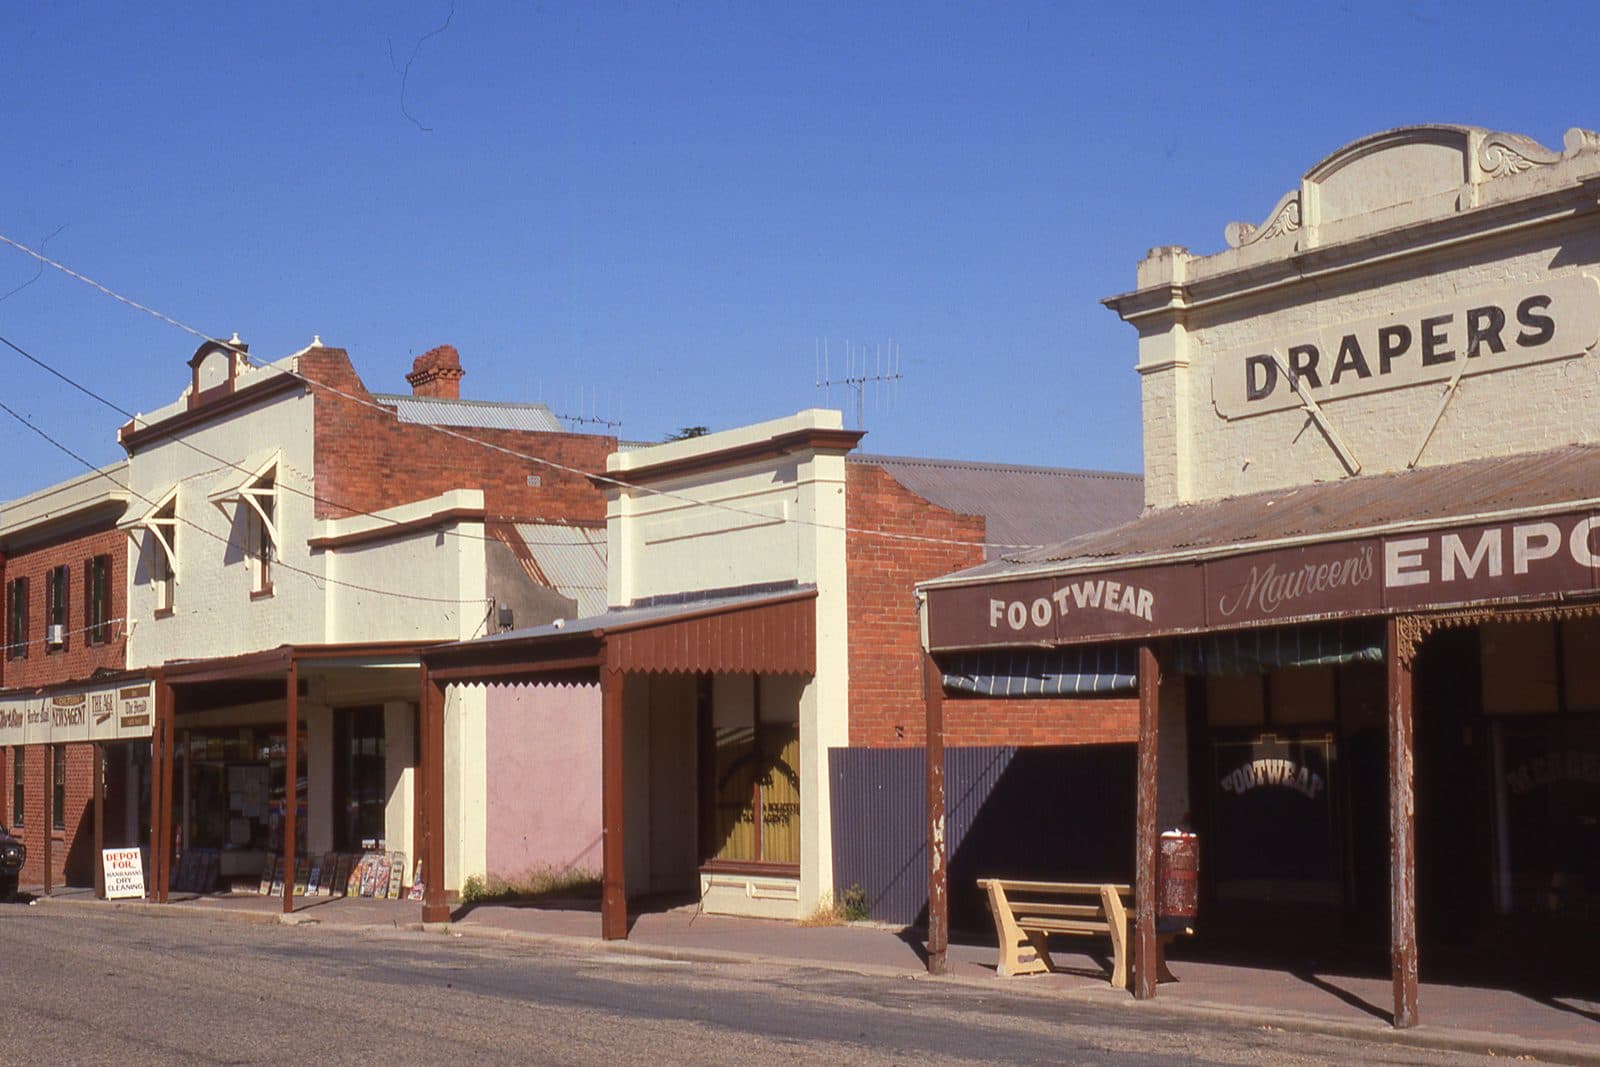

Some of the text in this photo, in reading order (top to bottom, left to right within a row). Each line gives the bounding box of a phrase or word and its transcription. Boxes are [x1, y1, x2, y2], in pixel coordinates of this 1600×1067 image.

[1246, 295, 1556, 402] DRAPERS
[1220, 545, 1374, 617] Maureen's
[989, 580, 1154, 631] FOOTWEAR
[52, 703, 86, 729] NEWSAGENT
[106, 852, 138, 861] DEPOT
[107, 883, 143, 892] CLEANING
